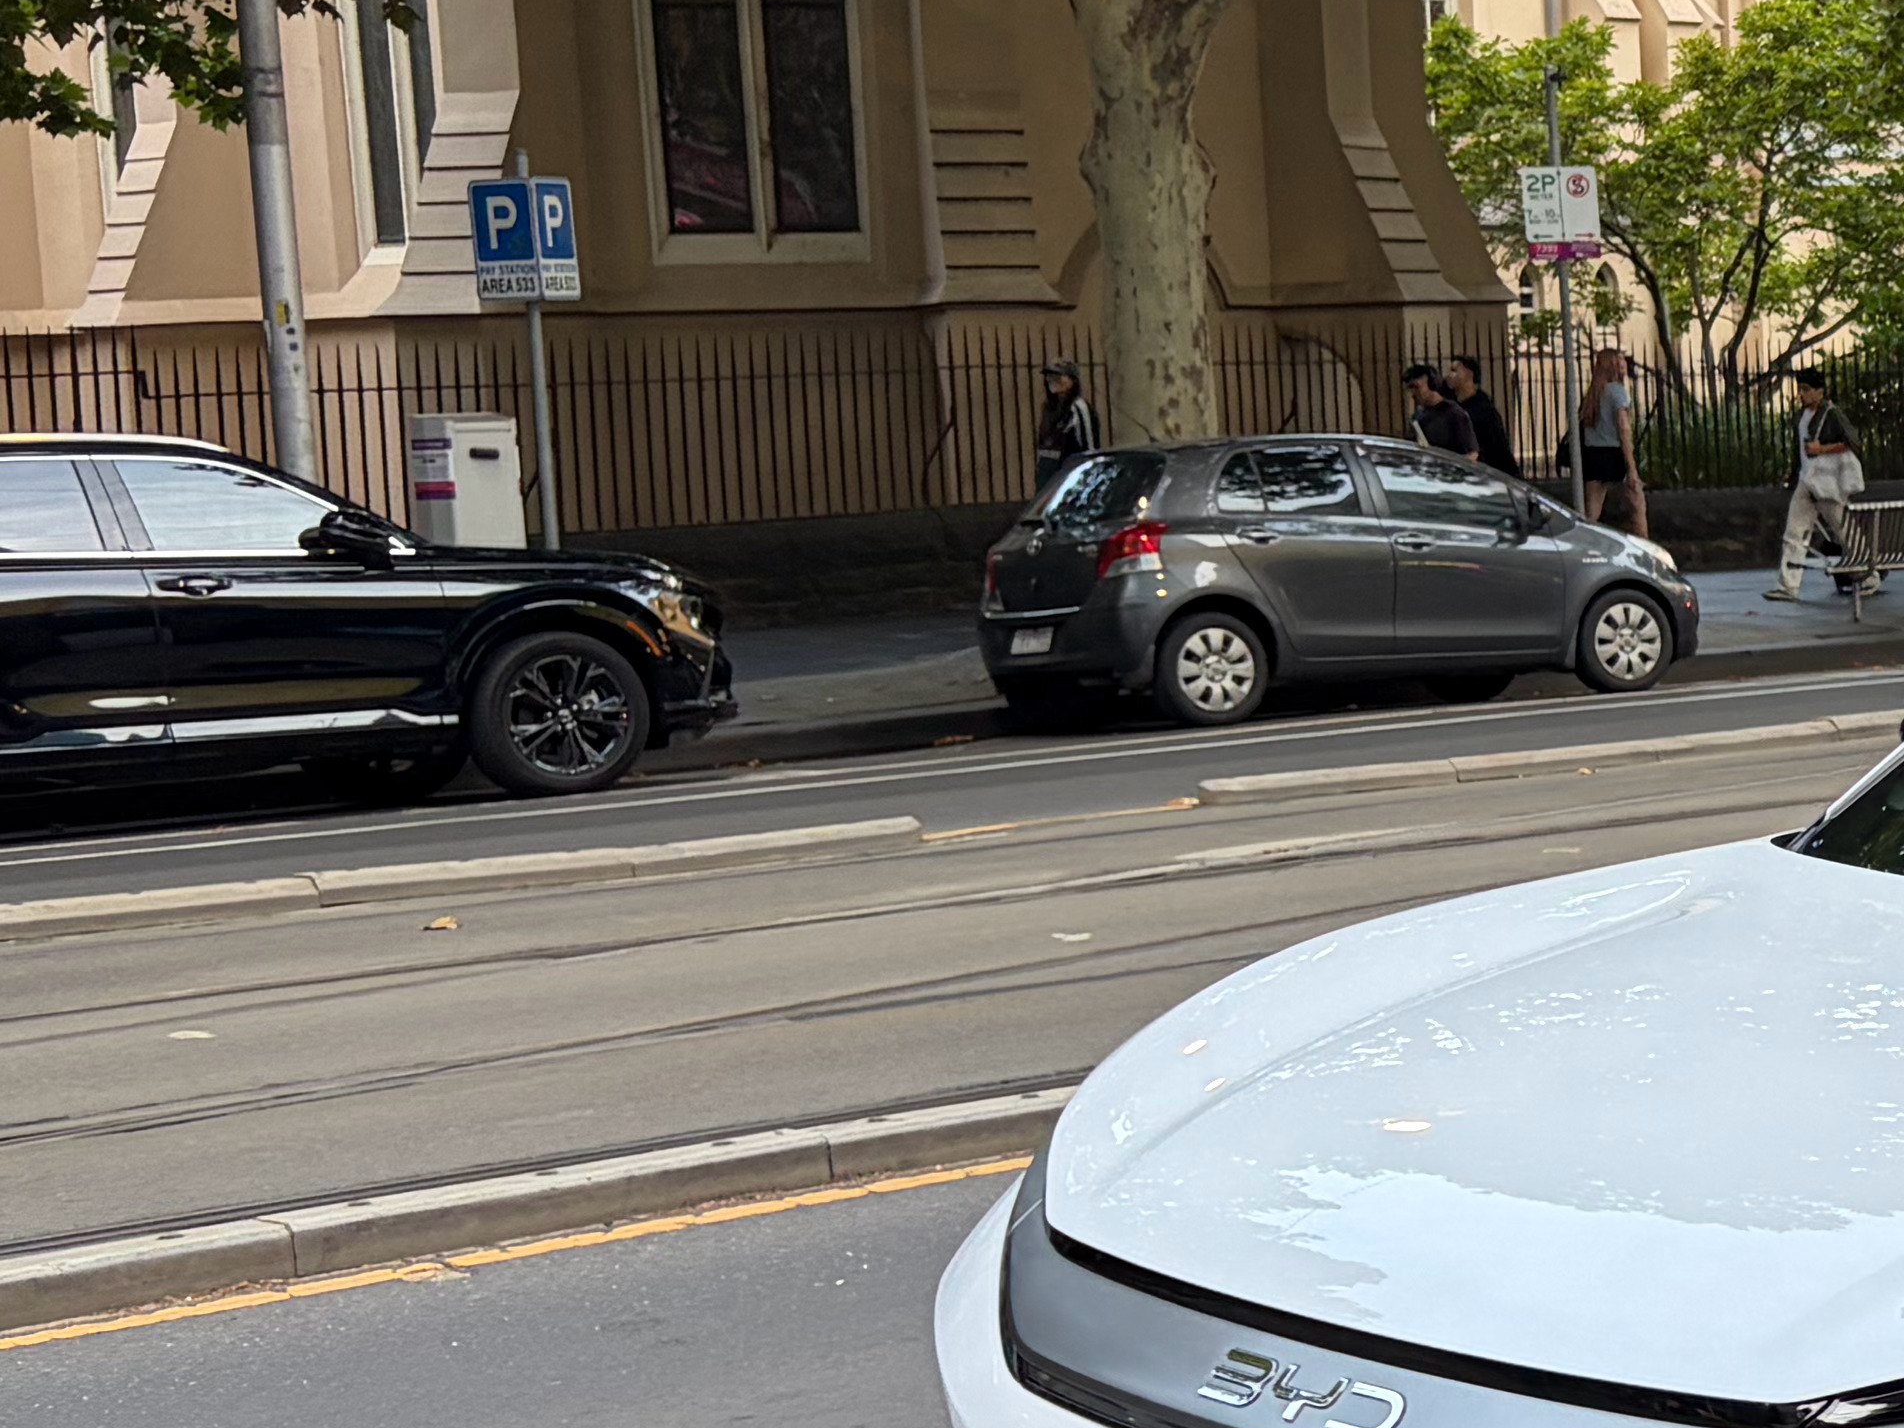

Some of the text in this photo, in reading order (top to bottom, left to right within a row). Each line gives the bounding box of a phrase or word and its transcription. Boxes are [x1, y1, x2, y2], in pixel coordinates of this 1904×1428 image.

[1525, 174, 1555, 192] 2P
[485, 195, 518, 250] P
[543, 194, 563, 248] P
[481, 276, 536, 293] AREA 533
